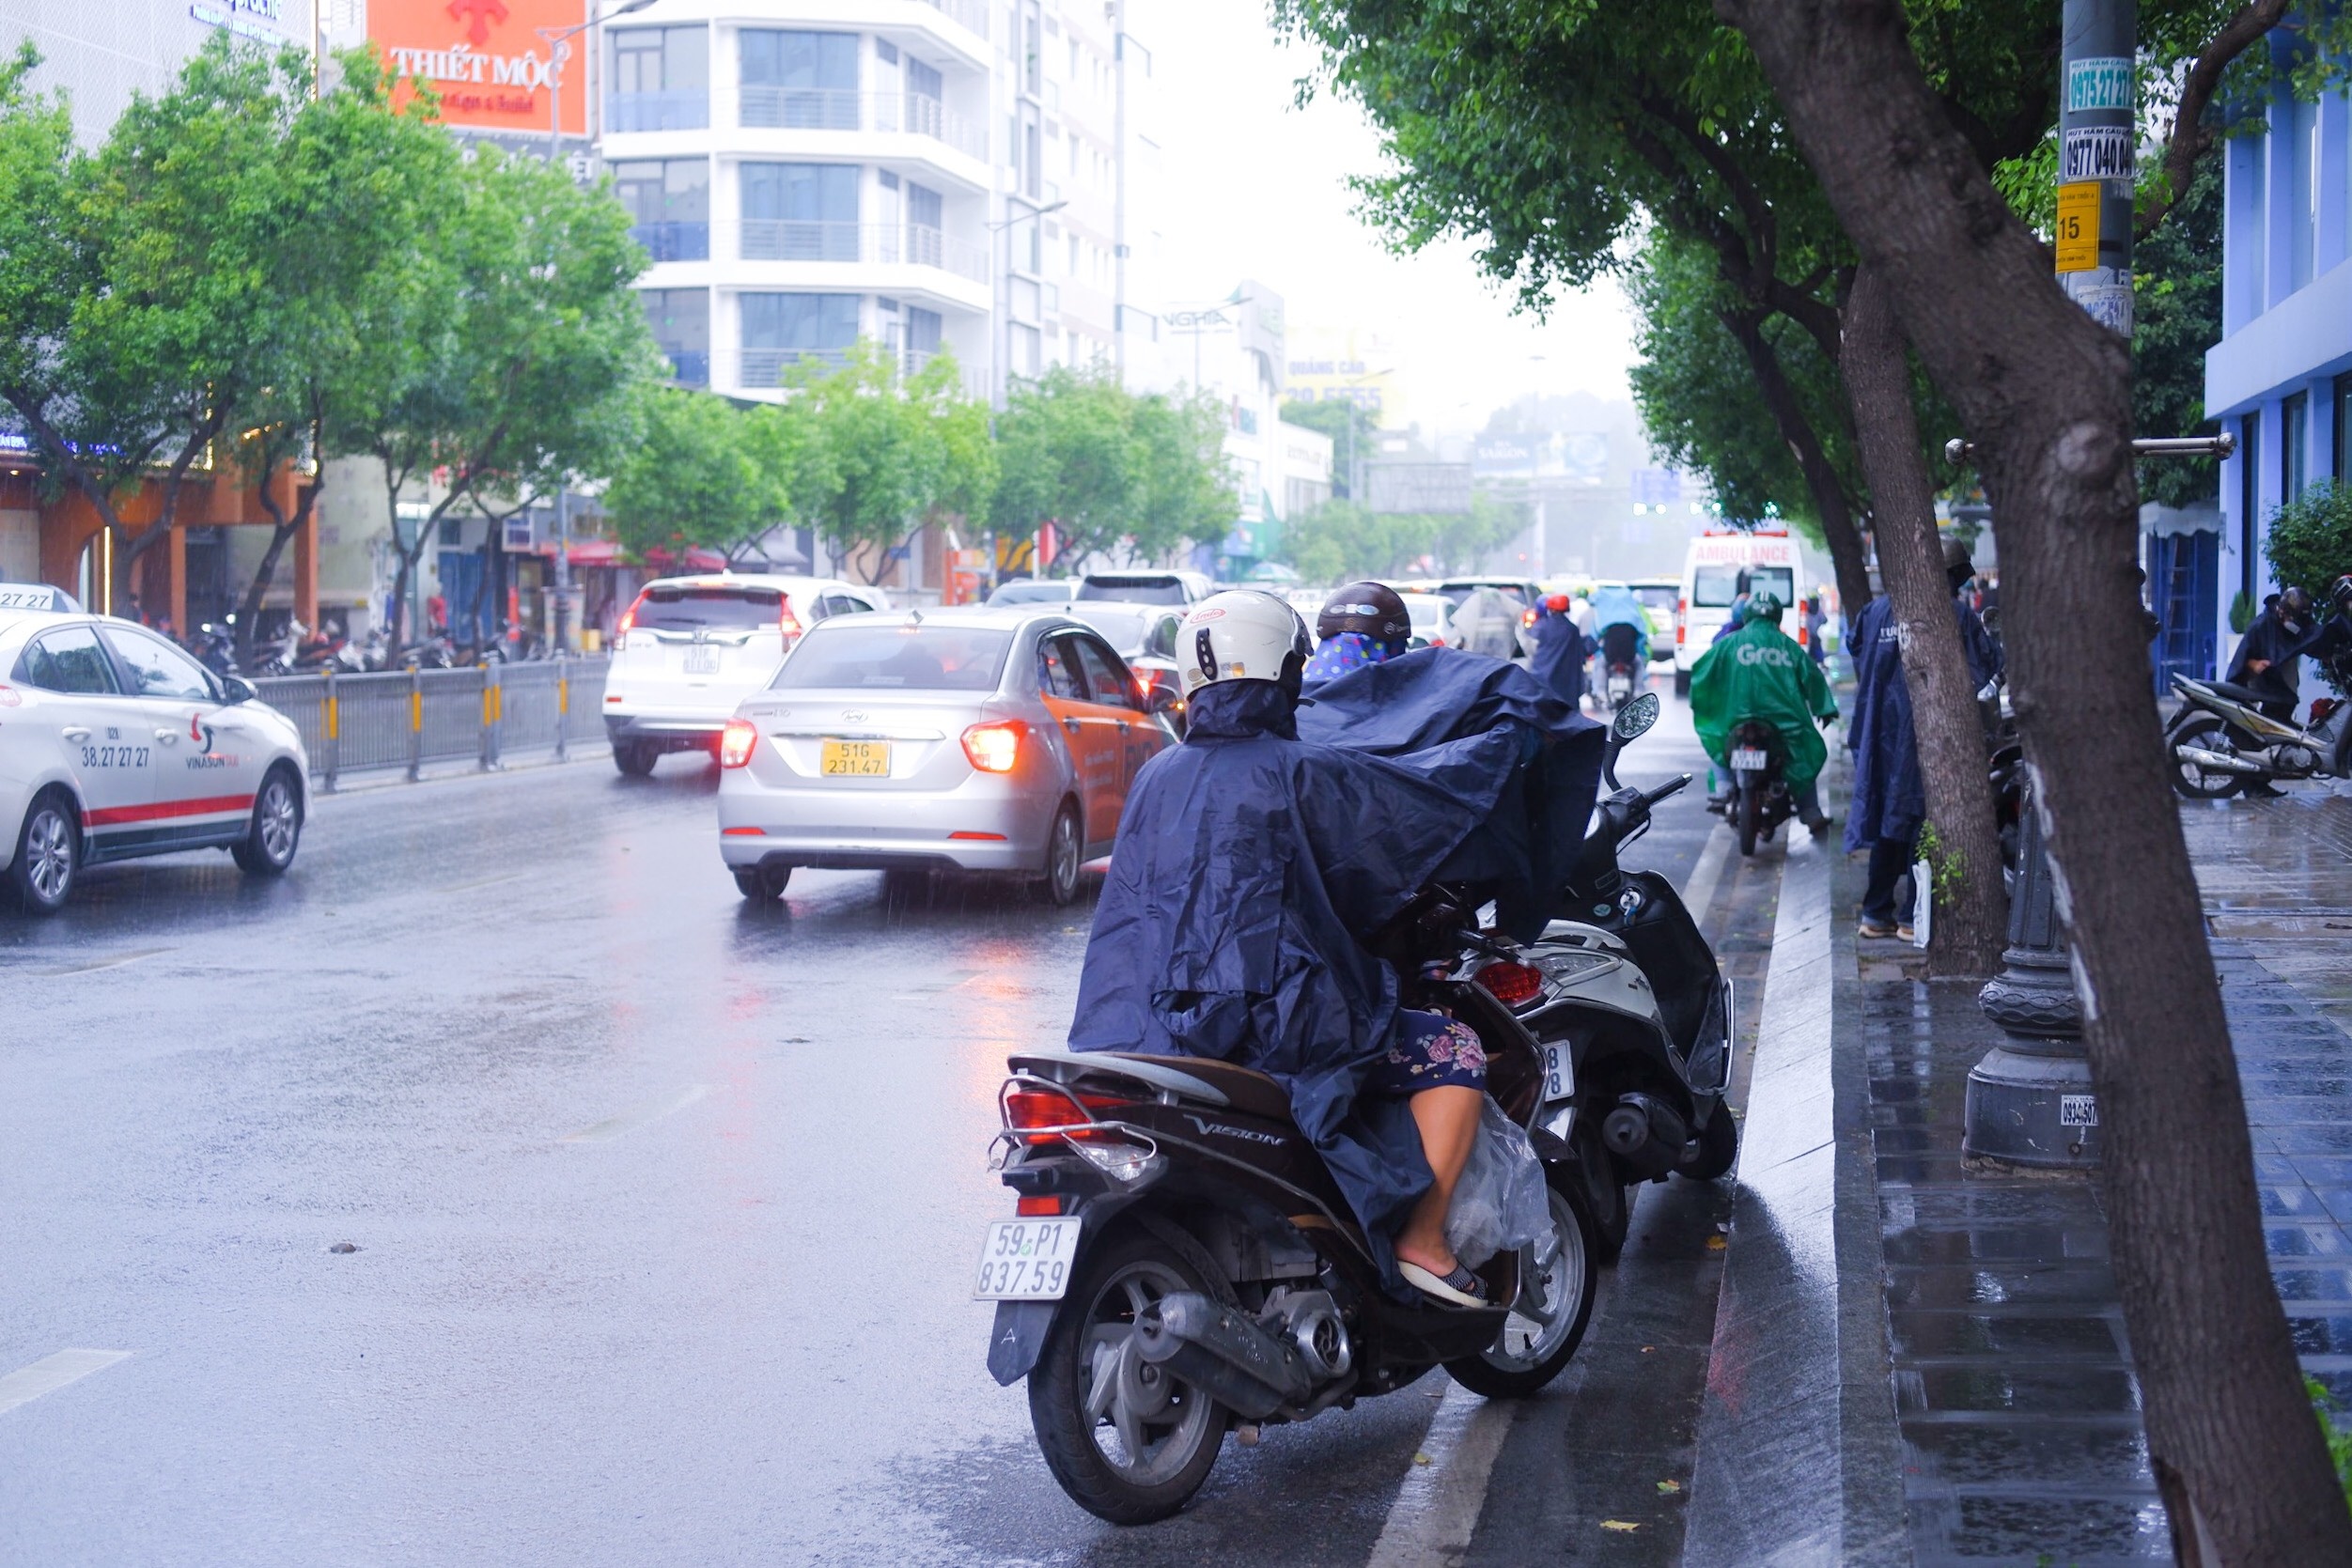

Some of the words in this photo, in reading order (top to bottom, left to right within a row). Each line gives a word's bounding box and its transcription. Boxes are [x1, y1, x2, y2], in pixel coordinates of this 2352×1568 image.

[390, 43, 489, 84] THIẾT
[492, 50, 565, 92] MỘC
[2060, 216, 2079, 240] 15
[1696, 546, 1789, 562] AMBULANCE
[1, 593, 23, 606] 27
[26, 594, 50, 608] 27
[82, 747, 115, 768] 38.27
[118, 747, 132, 768] 27
[135, 747, 149, 768] 27
[841, 743, 869, 757] 51G
[186, 755, 225, 769] VINASUN
[828, 759, 881, 774] 231.47
[978, 1261, 1065, 1293] 837.59
